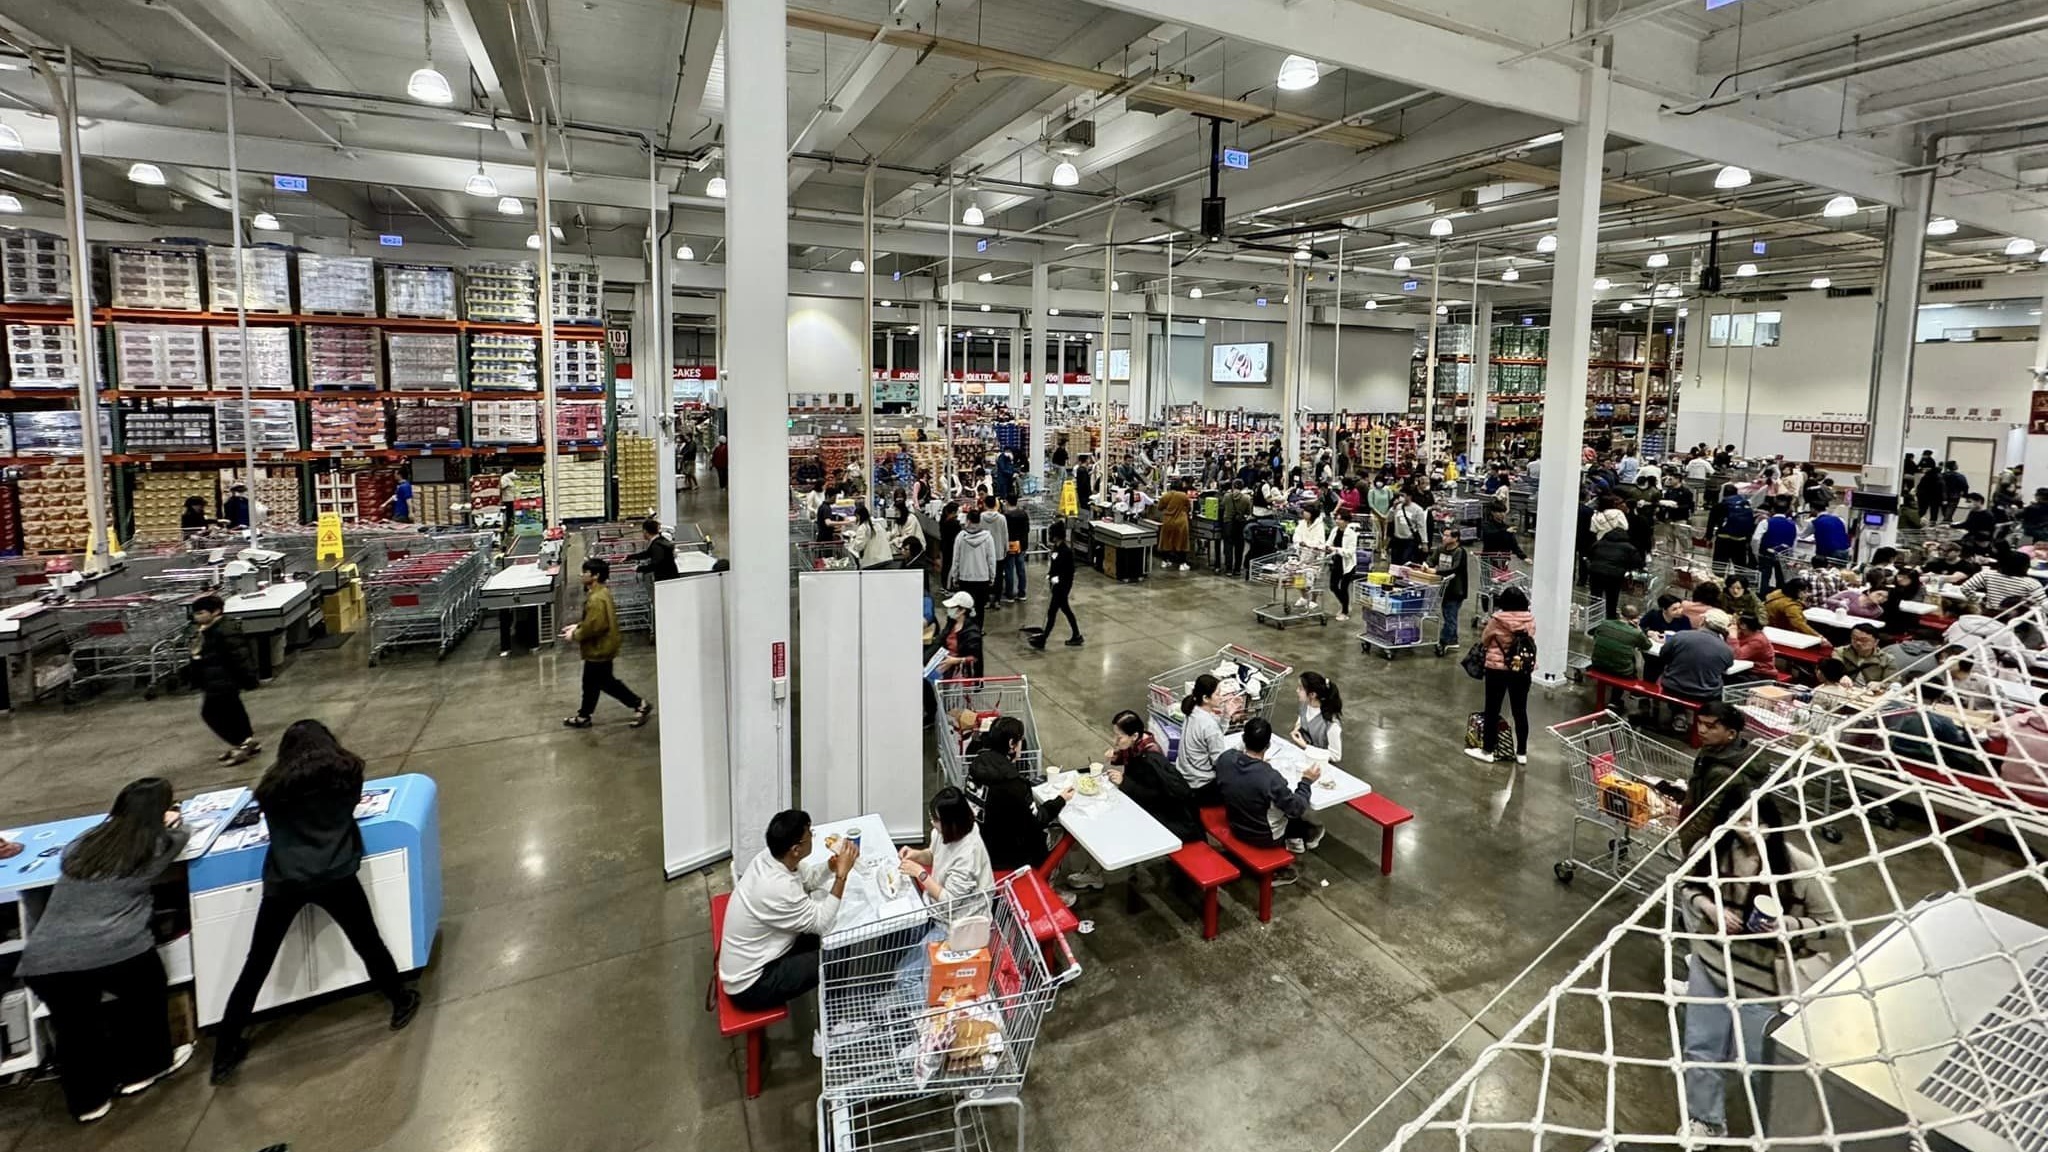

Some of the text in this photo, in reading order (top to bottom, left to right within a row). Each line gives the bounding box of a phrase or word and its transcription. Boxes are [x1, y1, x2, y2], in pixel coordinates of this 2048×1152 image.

[609, 331, 626, 342] 101
[673, 368, 701, 378] CAKES
[900, 372, 919, 381] PORK
